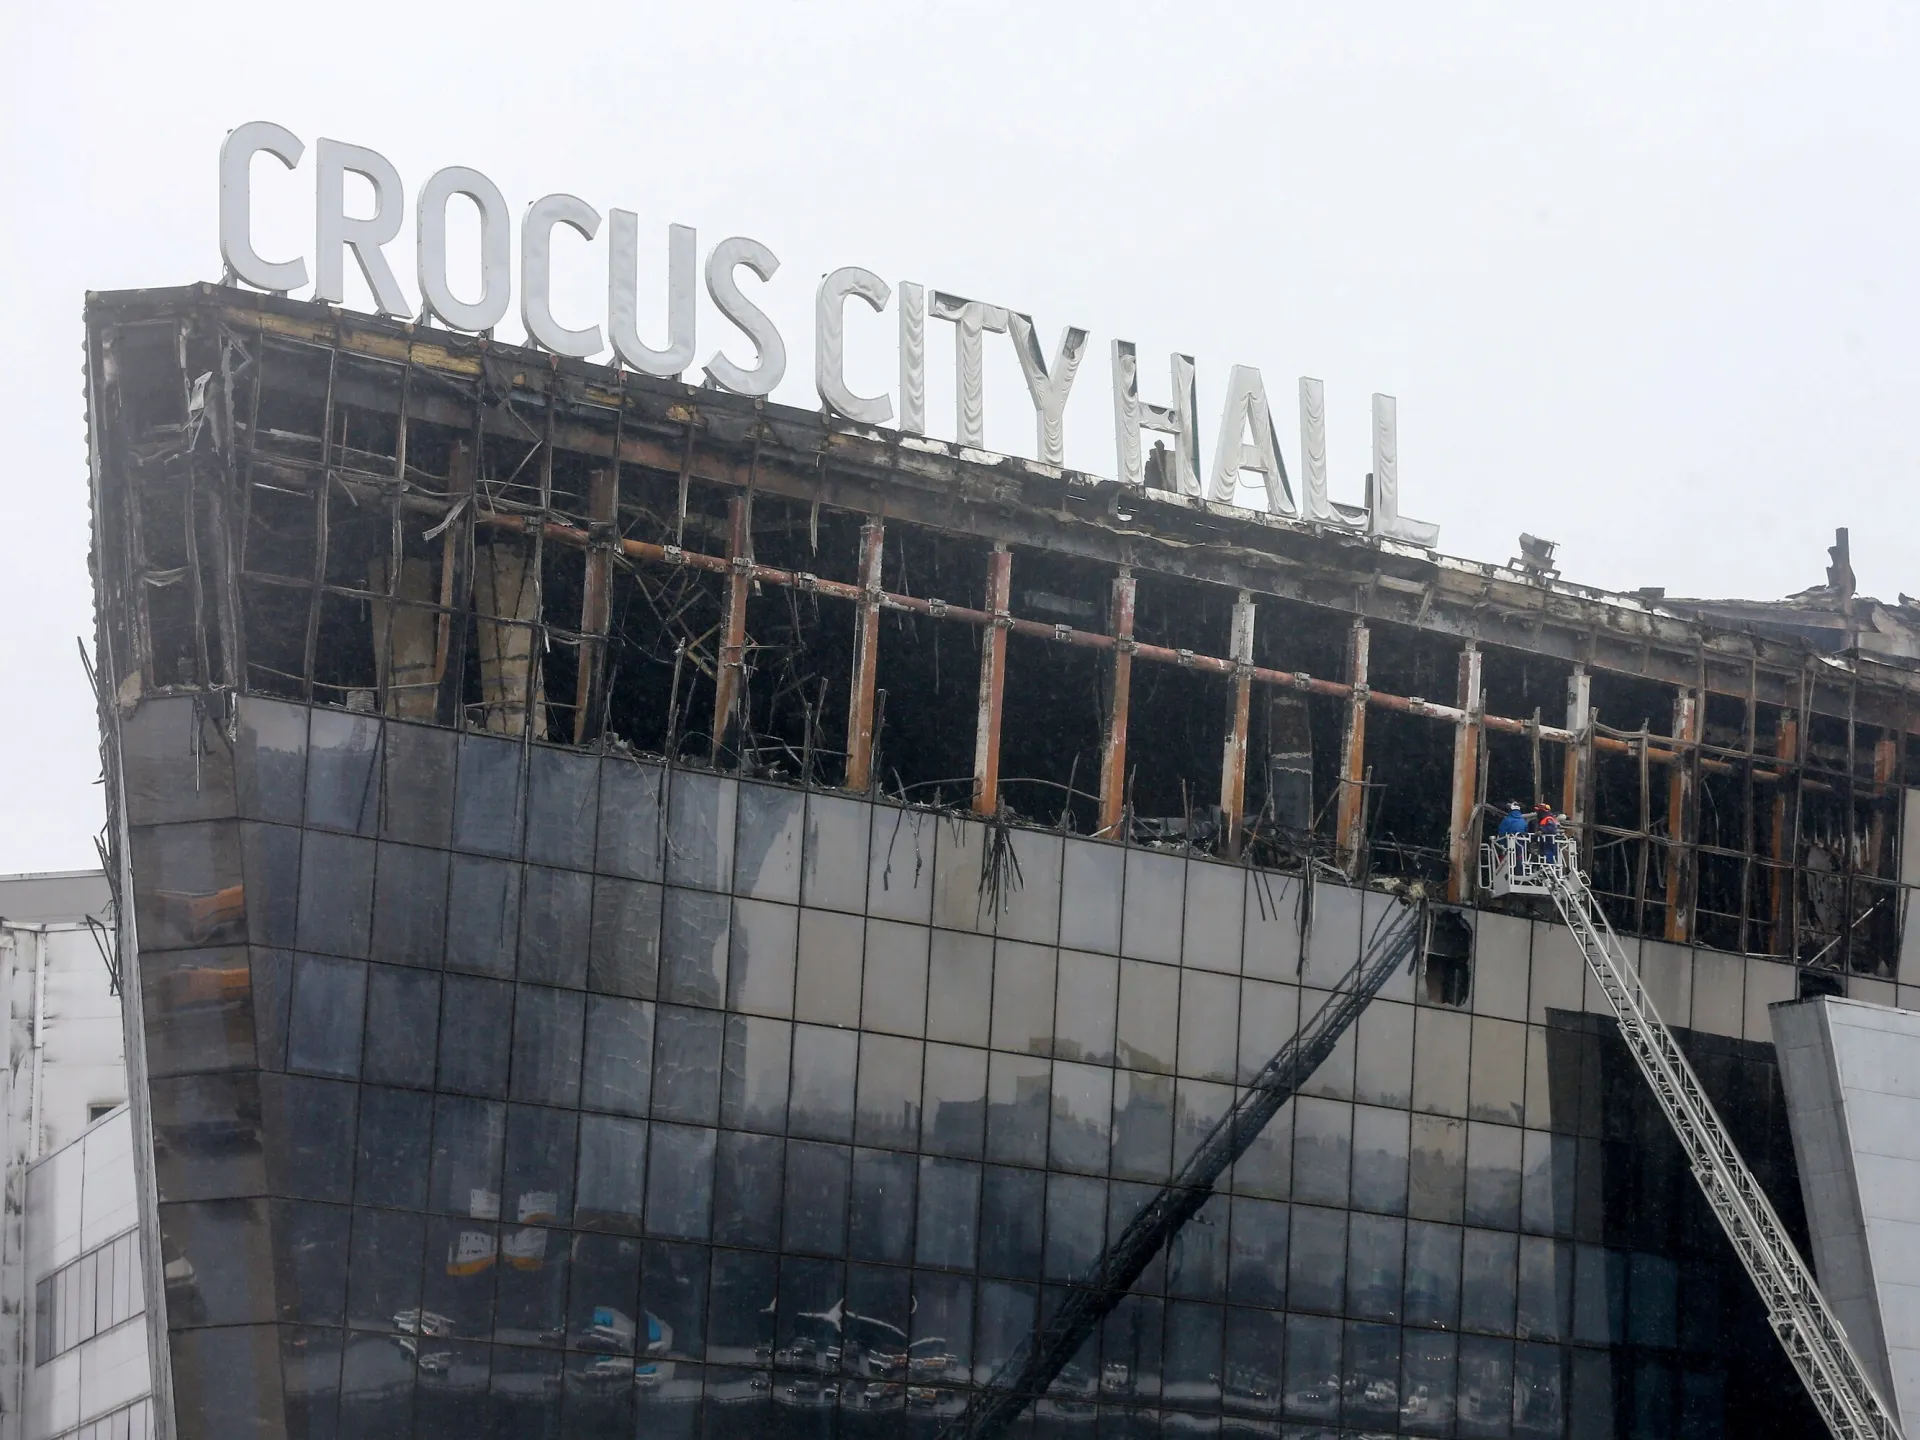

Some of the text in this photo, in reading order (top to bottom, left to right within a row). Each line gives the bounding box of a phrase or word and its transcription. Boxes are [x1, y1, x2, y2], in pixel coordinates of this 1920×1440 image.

[219, 121, 1440, 548] CROCUS CITY HALL
